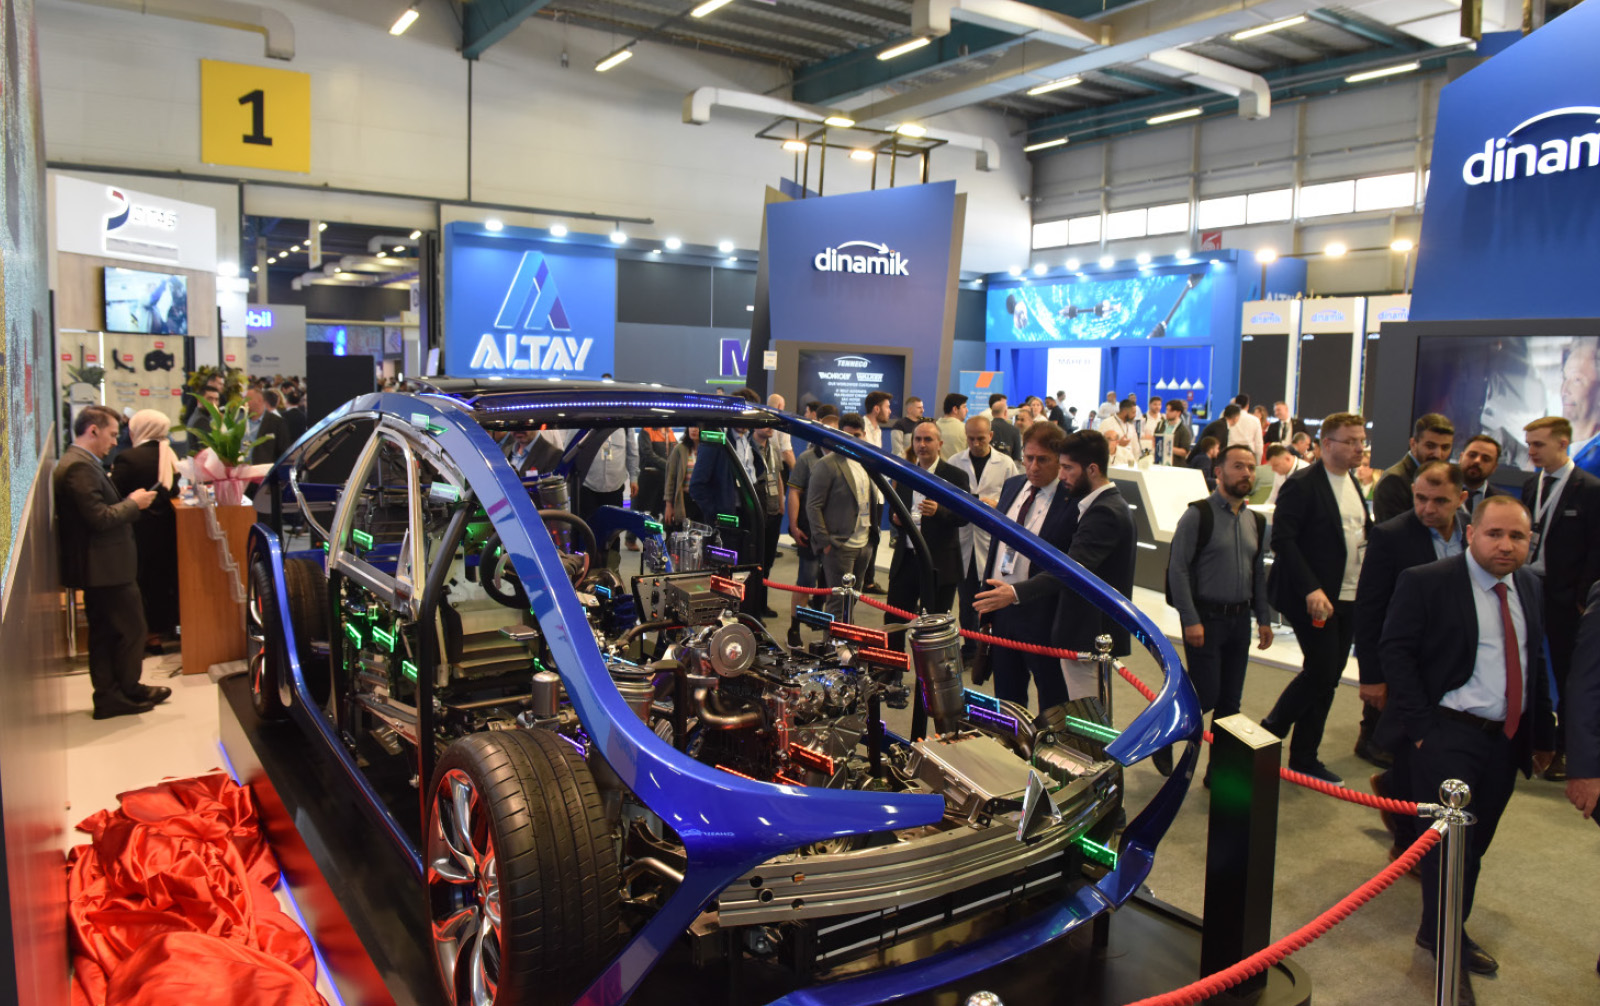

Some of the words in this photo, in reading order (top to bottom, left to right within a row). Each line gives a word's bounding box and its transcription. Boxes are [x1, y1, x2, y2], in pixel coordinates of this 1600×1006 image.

[238, 89, 273, 147] 1
[814, 247, 909, 276] dinamik
[246, 310, 272, 328] bil
[469, 333, 594, 371] ALTAY
